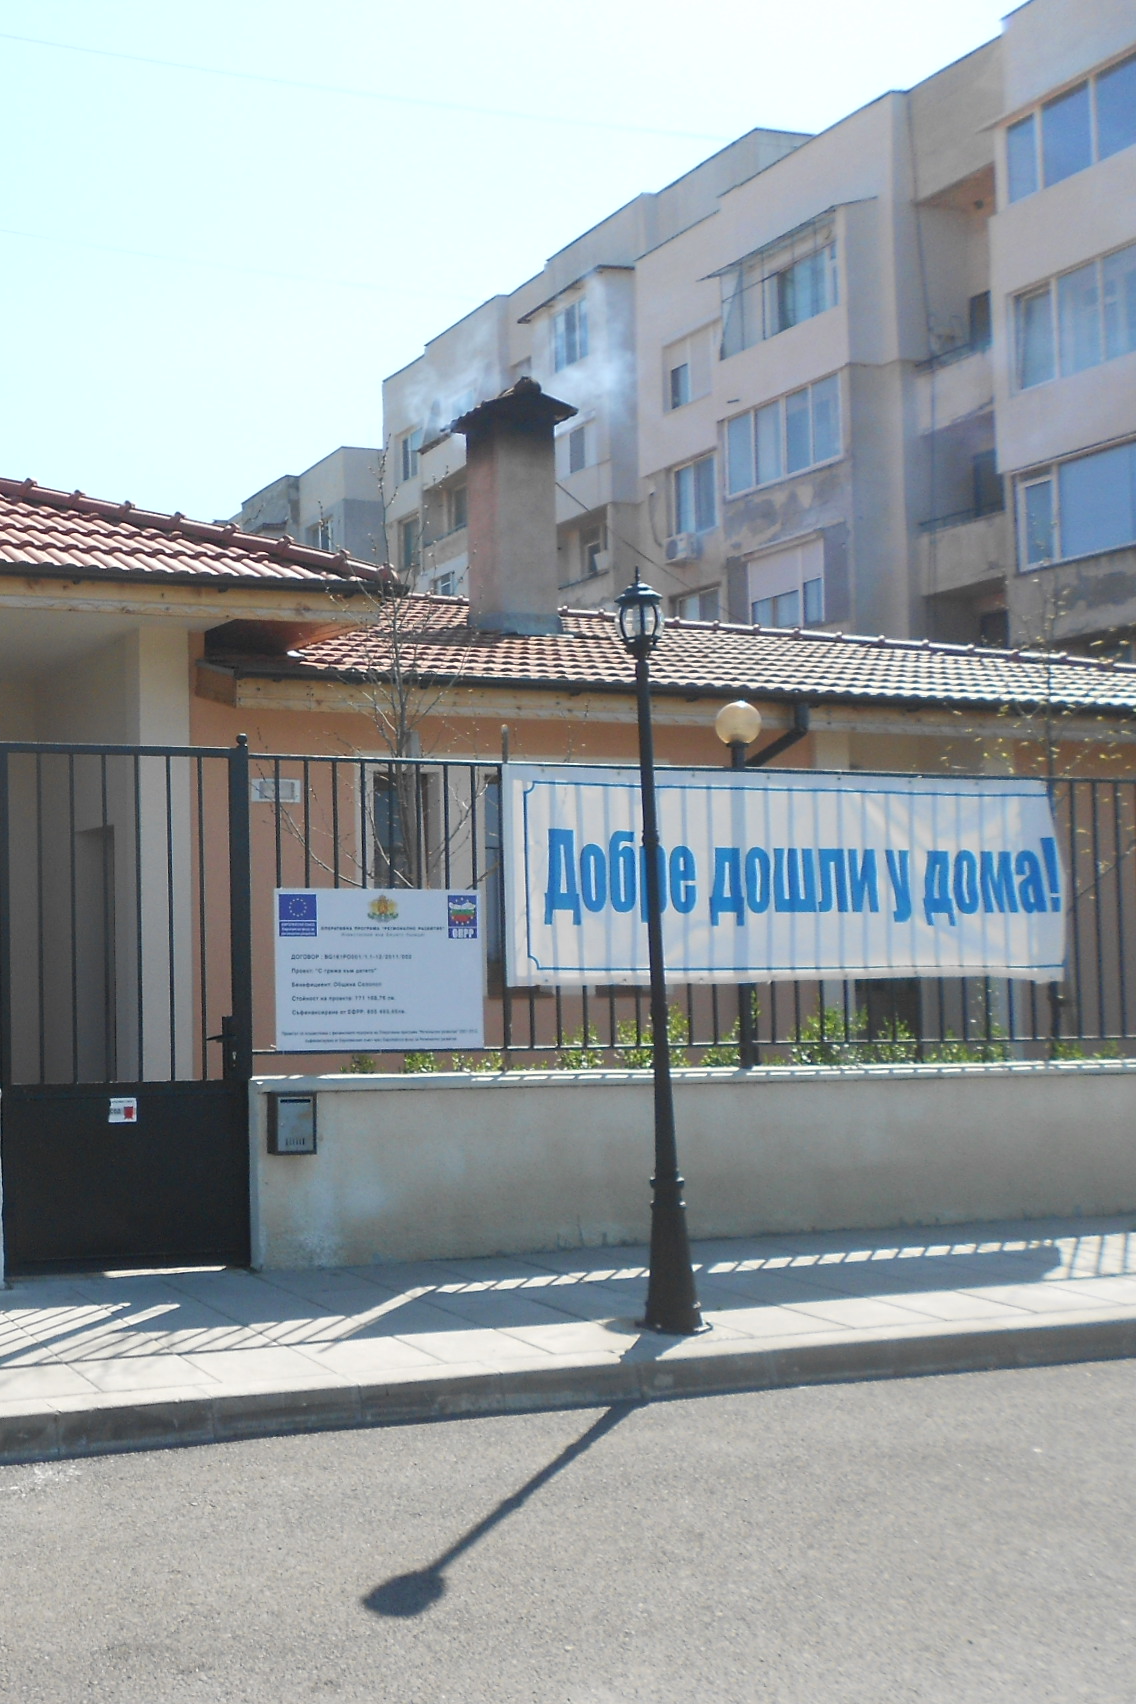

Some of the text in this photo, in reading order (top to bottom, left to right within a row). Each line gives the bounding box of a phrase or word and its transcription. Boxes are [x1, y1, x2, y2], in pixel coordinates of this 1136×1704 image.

[710, 847, 879, 926] дошли
[885, 849, 911, 922] у
[923, 837, 1060, 926] дома!
